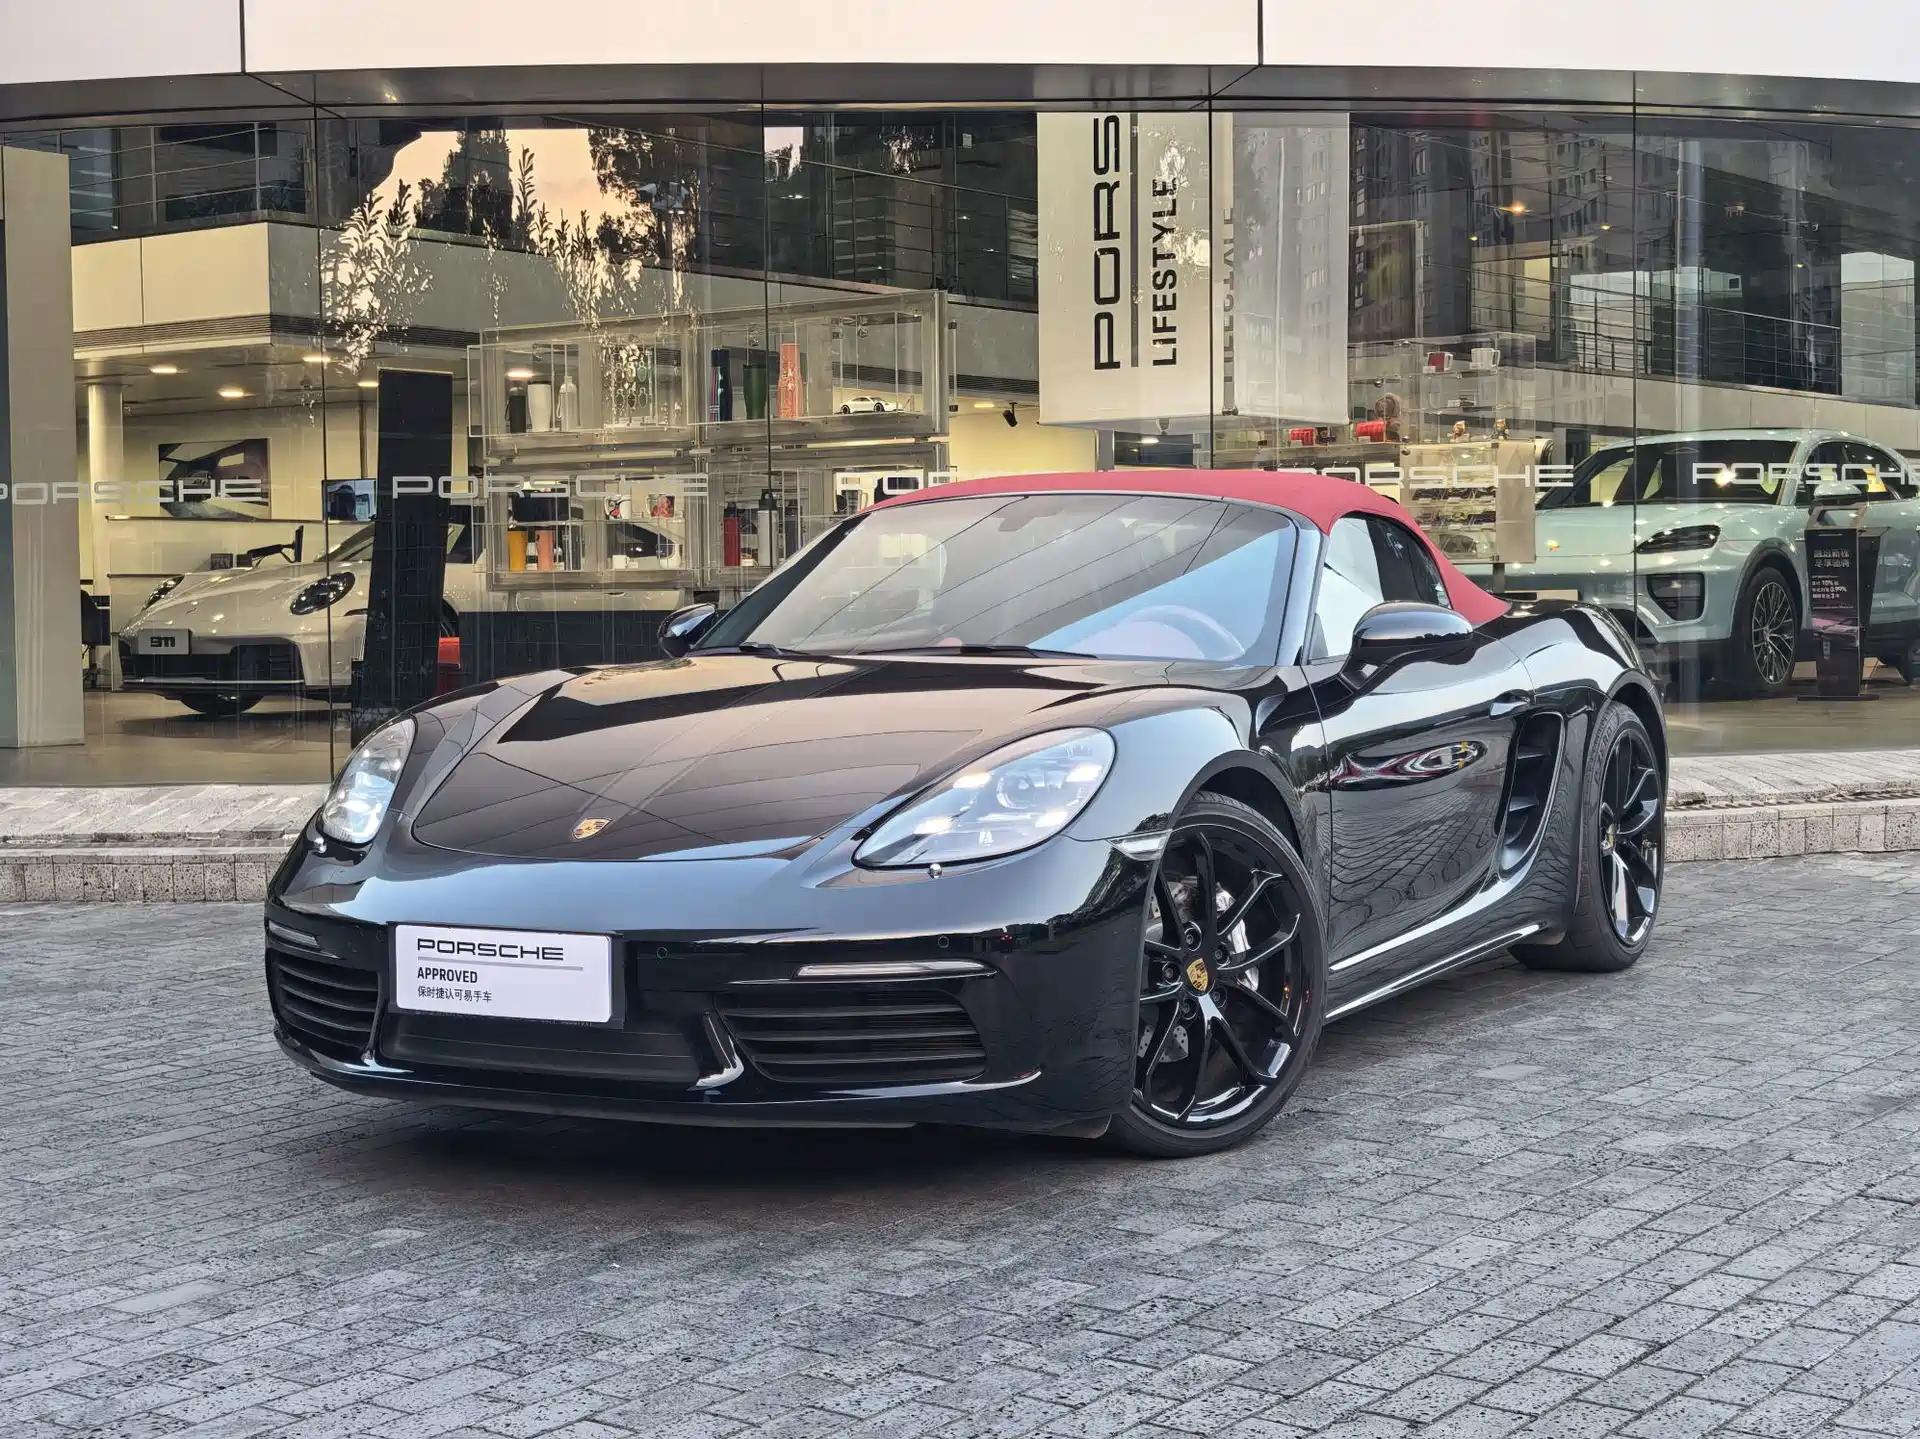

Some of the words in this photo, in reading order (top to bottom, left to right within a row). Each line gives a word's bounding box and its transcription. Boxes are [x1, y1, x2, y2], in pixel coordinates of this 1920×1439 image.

[1093, 114, 1121, 371] PORS
[1152, 177, 1178, 367] LIFESTYLE
[0, 479, 263, 505] ORSCHE
[392, 473, 709, 499] PORSCHE
[150, 636, 176, 648] 911
[417, 938, 564, 961] PORSCHE
[417, 966, 478, 984] APPROVED
[417, 985, 492, 1003] 保时捷认可易手车
